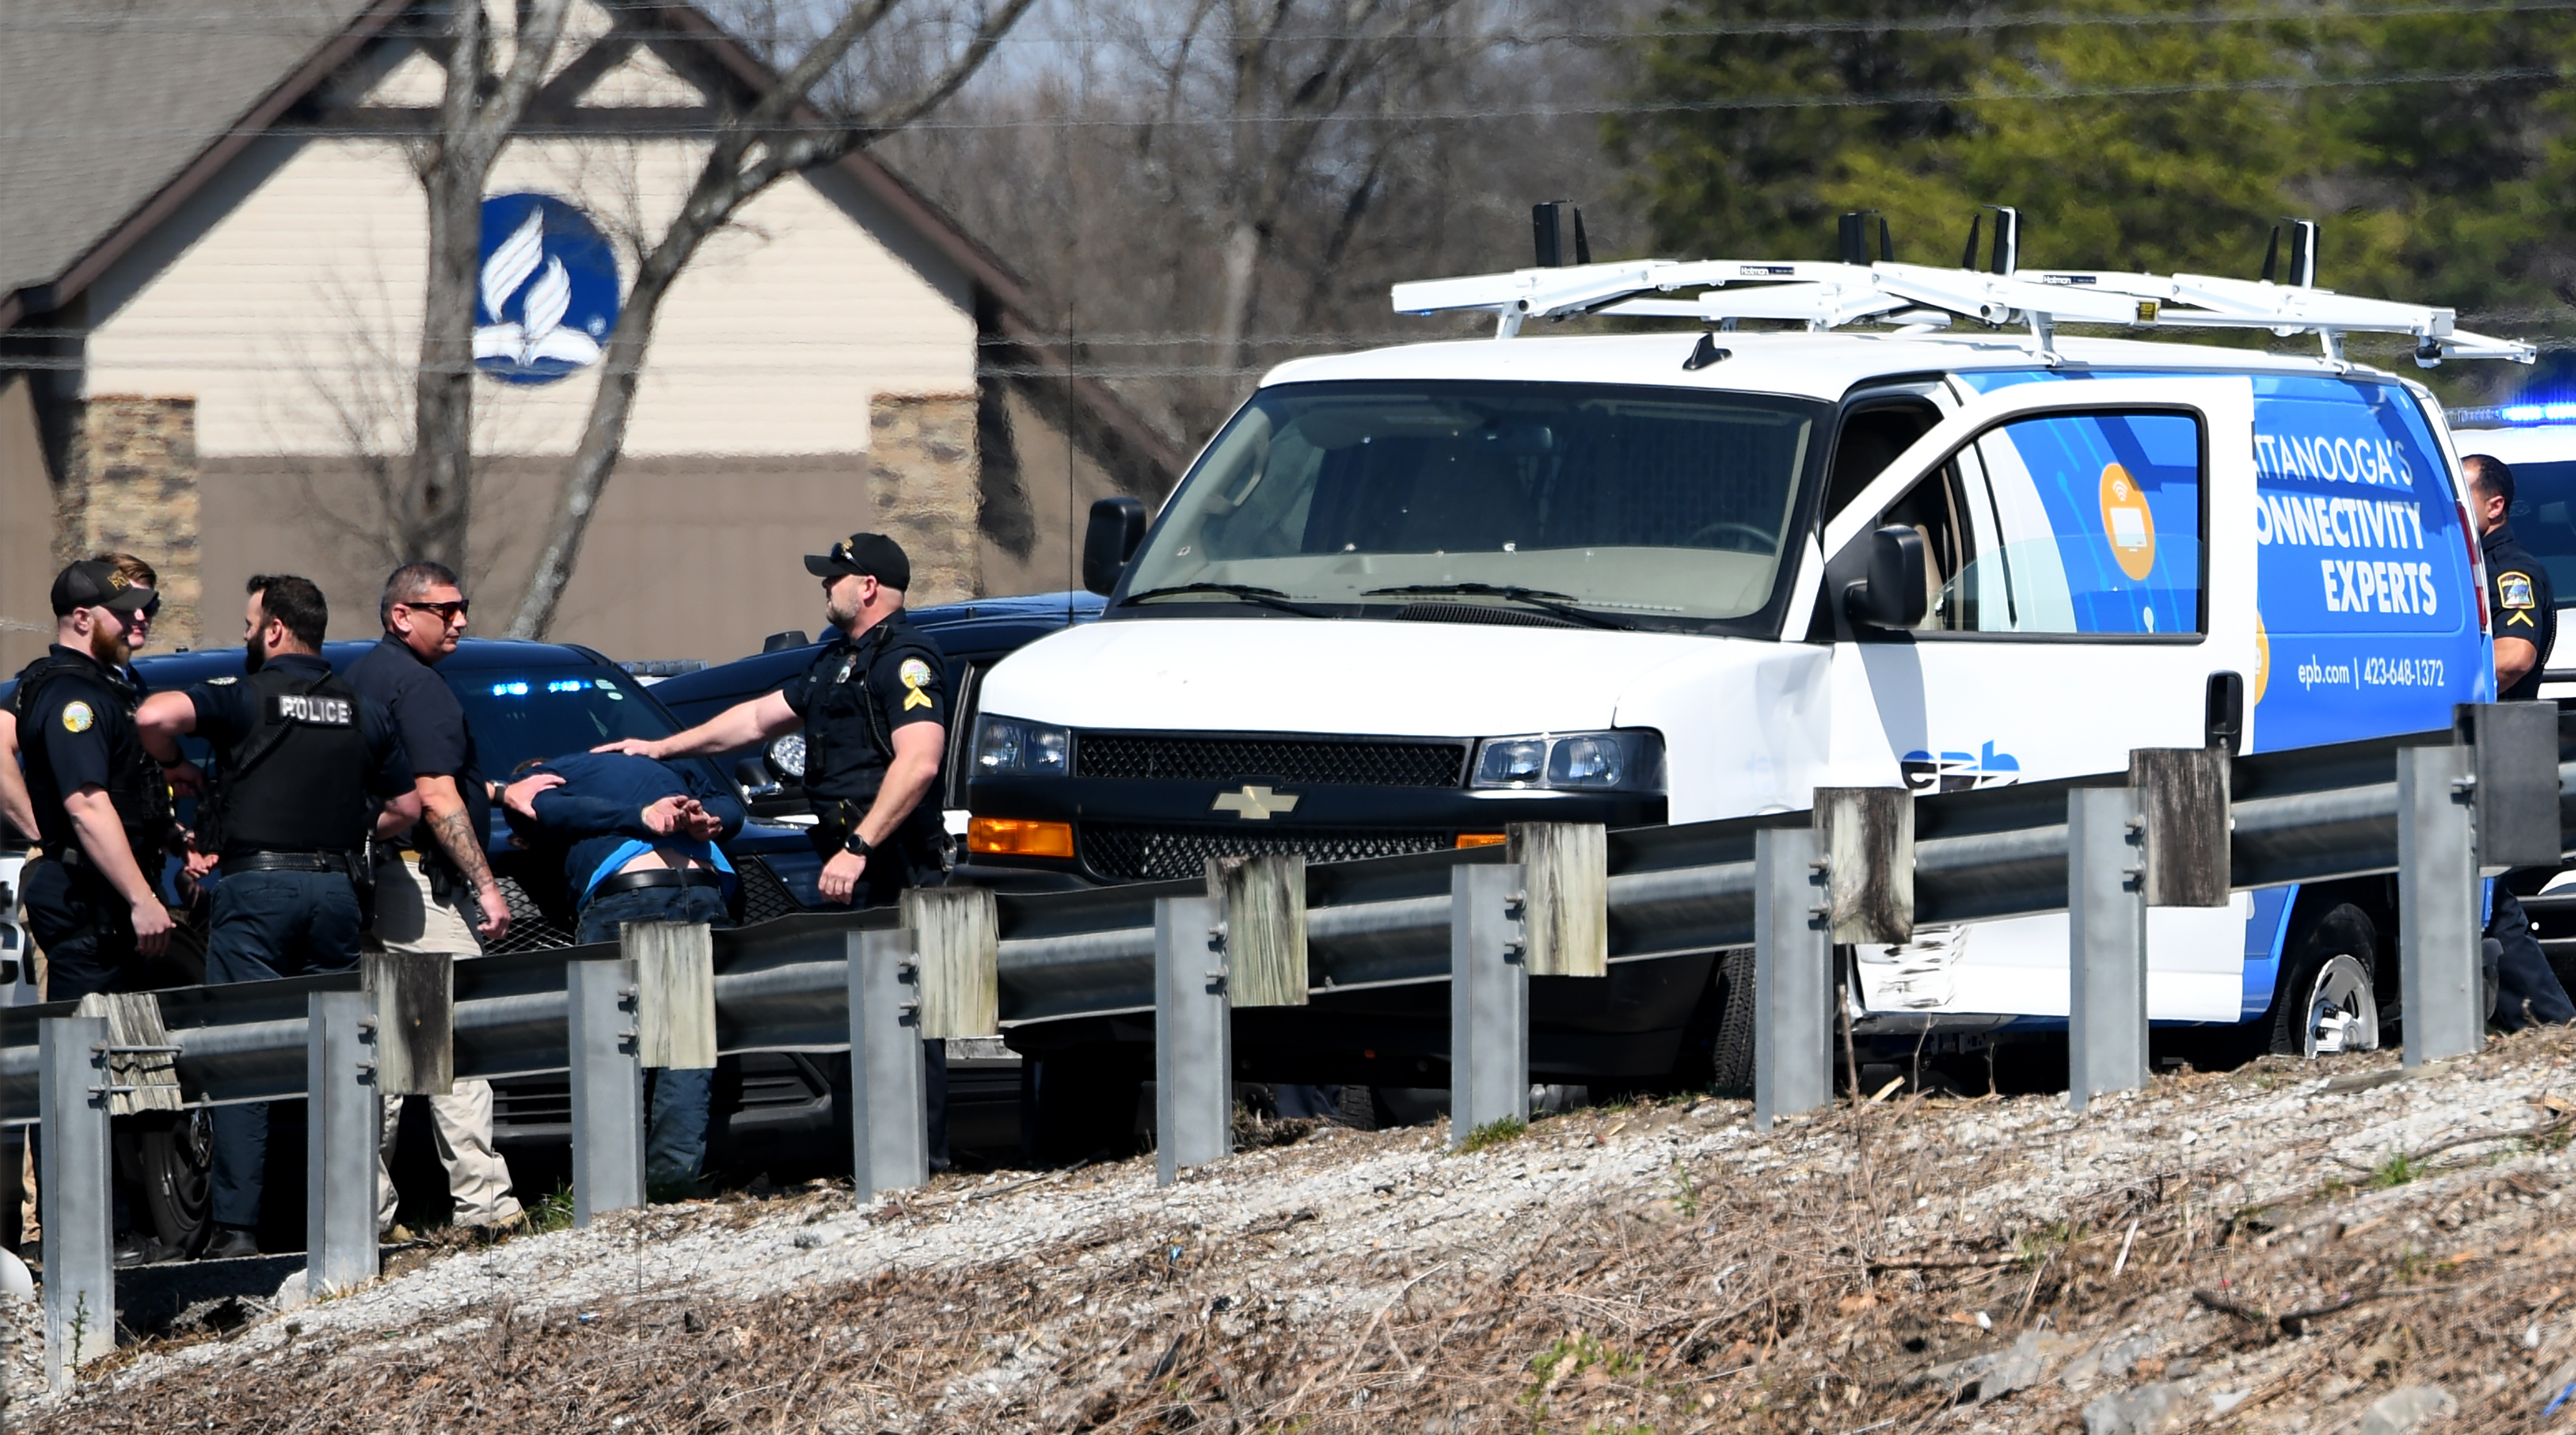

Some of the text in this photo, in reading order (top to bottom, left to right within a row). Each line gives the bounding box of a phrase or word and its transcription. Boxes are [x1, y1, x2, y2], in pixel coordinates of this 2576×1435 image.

[2254, 434, 2413, 486] TTANOOGA'S
[2321, 560, 2437, 615] EXPERTS
[2298, 654, 2350, 691] epb.com
[2364, 657, 2444, 687] 423-648-1372
[281, 696, 349, 724] POLICE
[1900, 739, 2021, 792] epb
